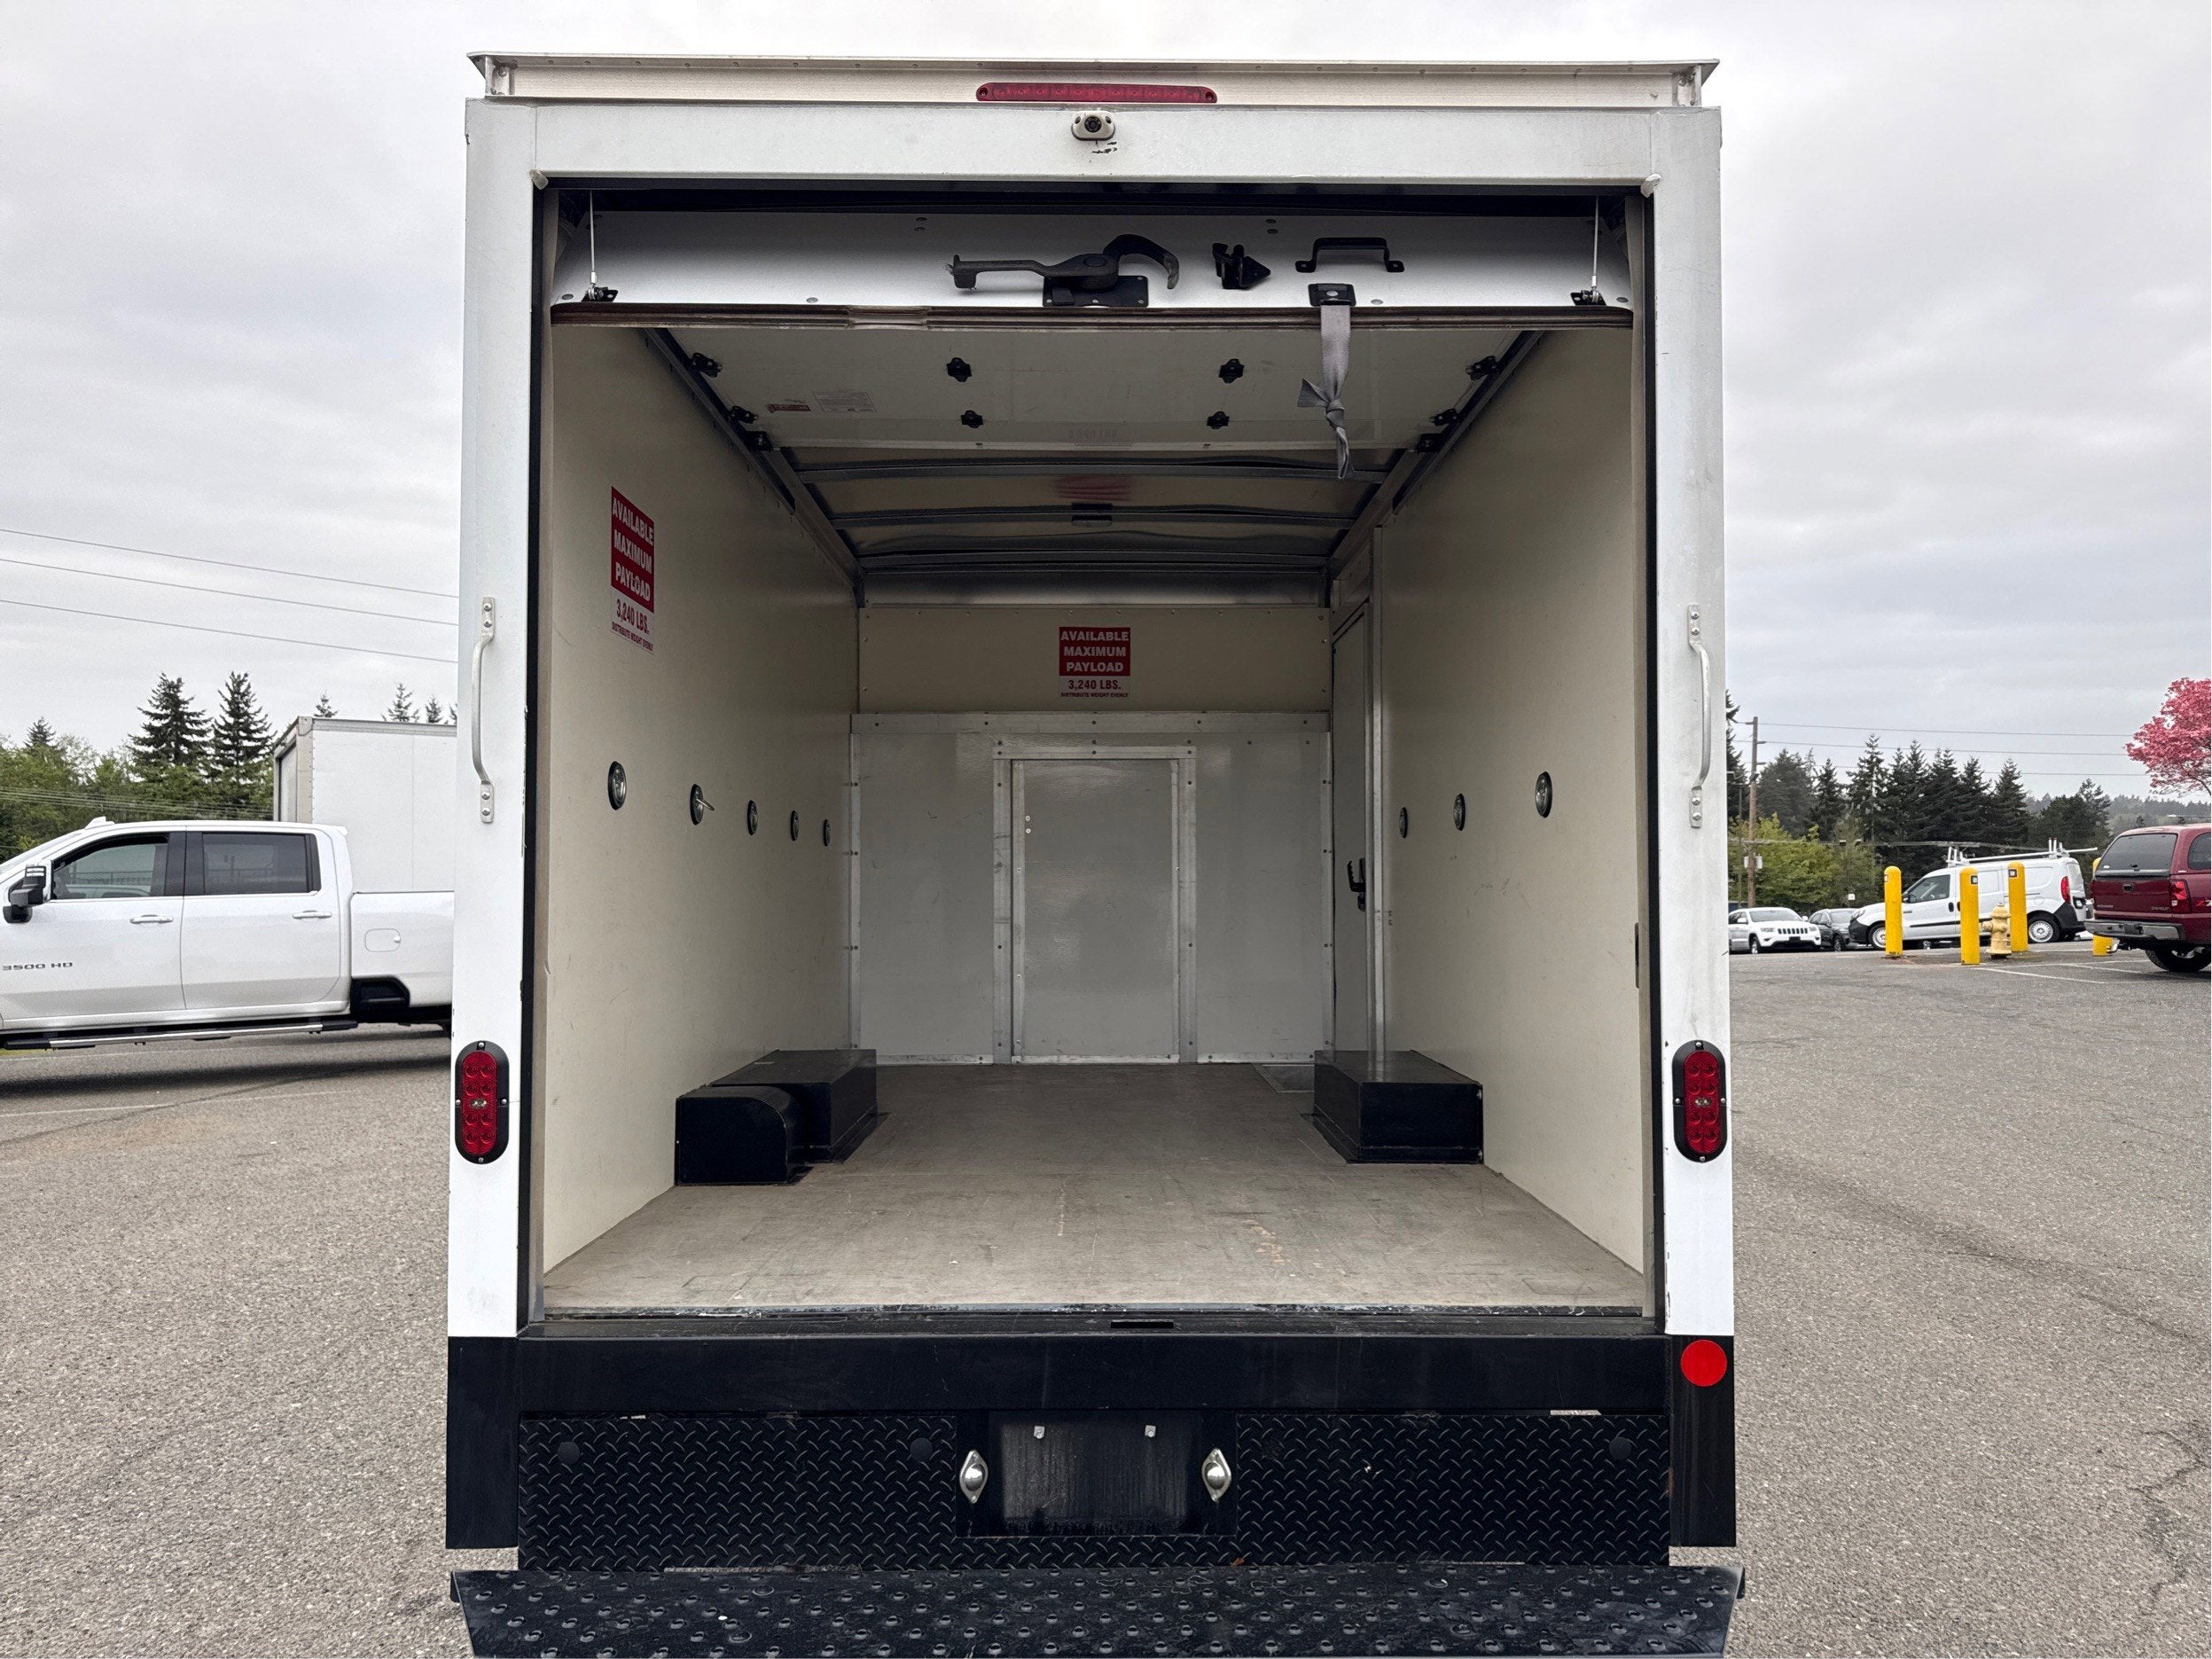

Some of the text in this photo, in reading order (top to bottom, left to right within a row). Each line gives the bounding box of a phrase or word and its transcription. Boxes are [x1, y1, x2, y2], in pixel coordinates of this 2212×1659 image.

[612, 497, 654, 546] AVAILABLE
[614, 529, 653, 575] MAXIMUM
[615, 561, 651, 602] PAYLOAD
[636, 609, 650, 635] LBS.
[1060, 630, 1129, 641] AVAILABLE
[1064, 646, 1127, 657] MAXIMUM
[1066, 661, 1124, 672] PAYLOAD
[1068, 679, 1122, 691] 3,240 LBS.
